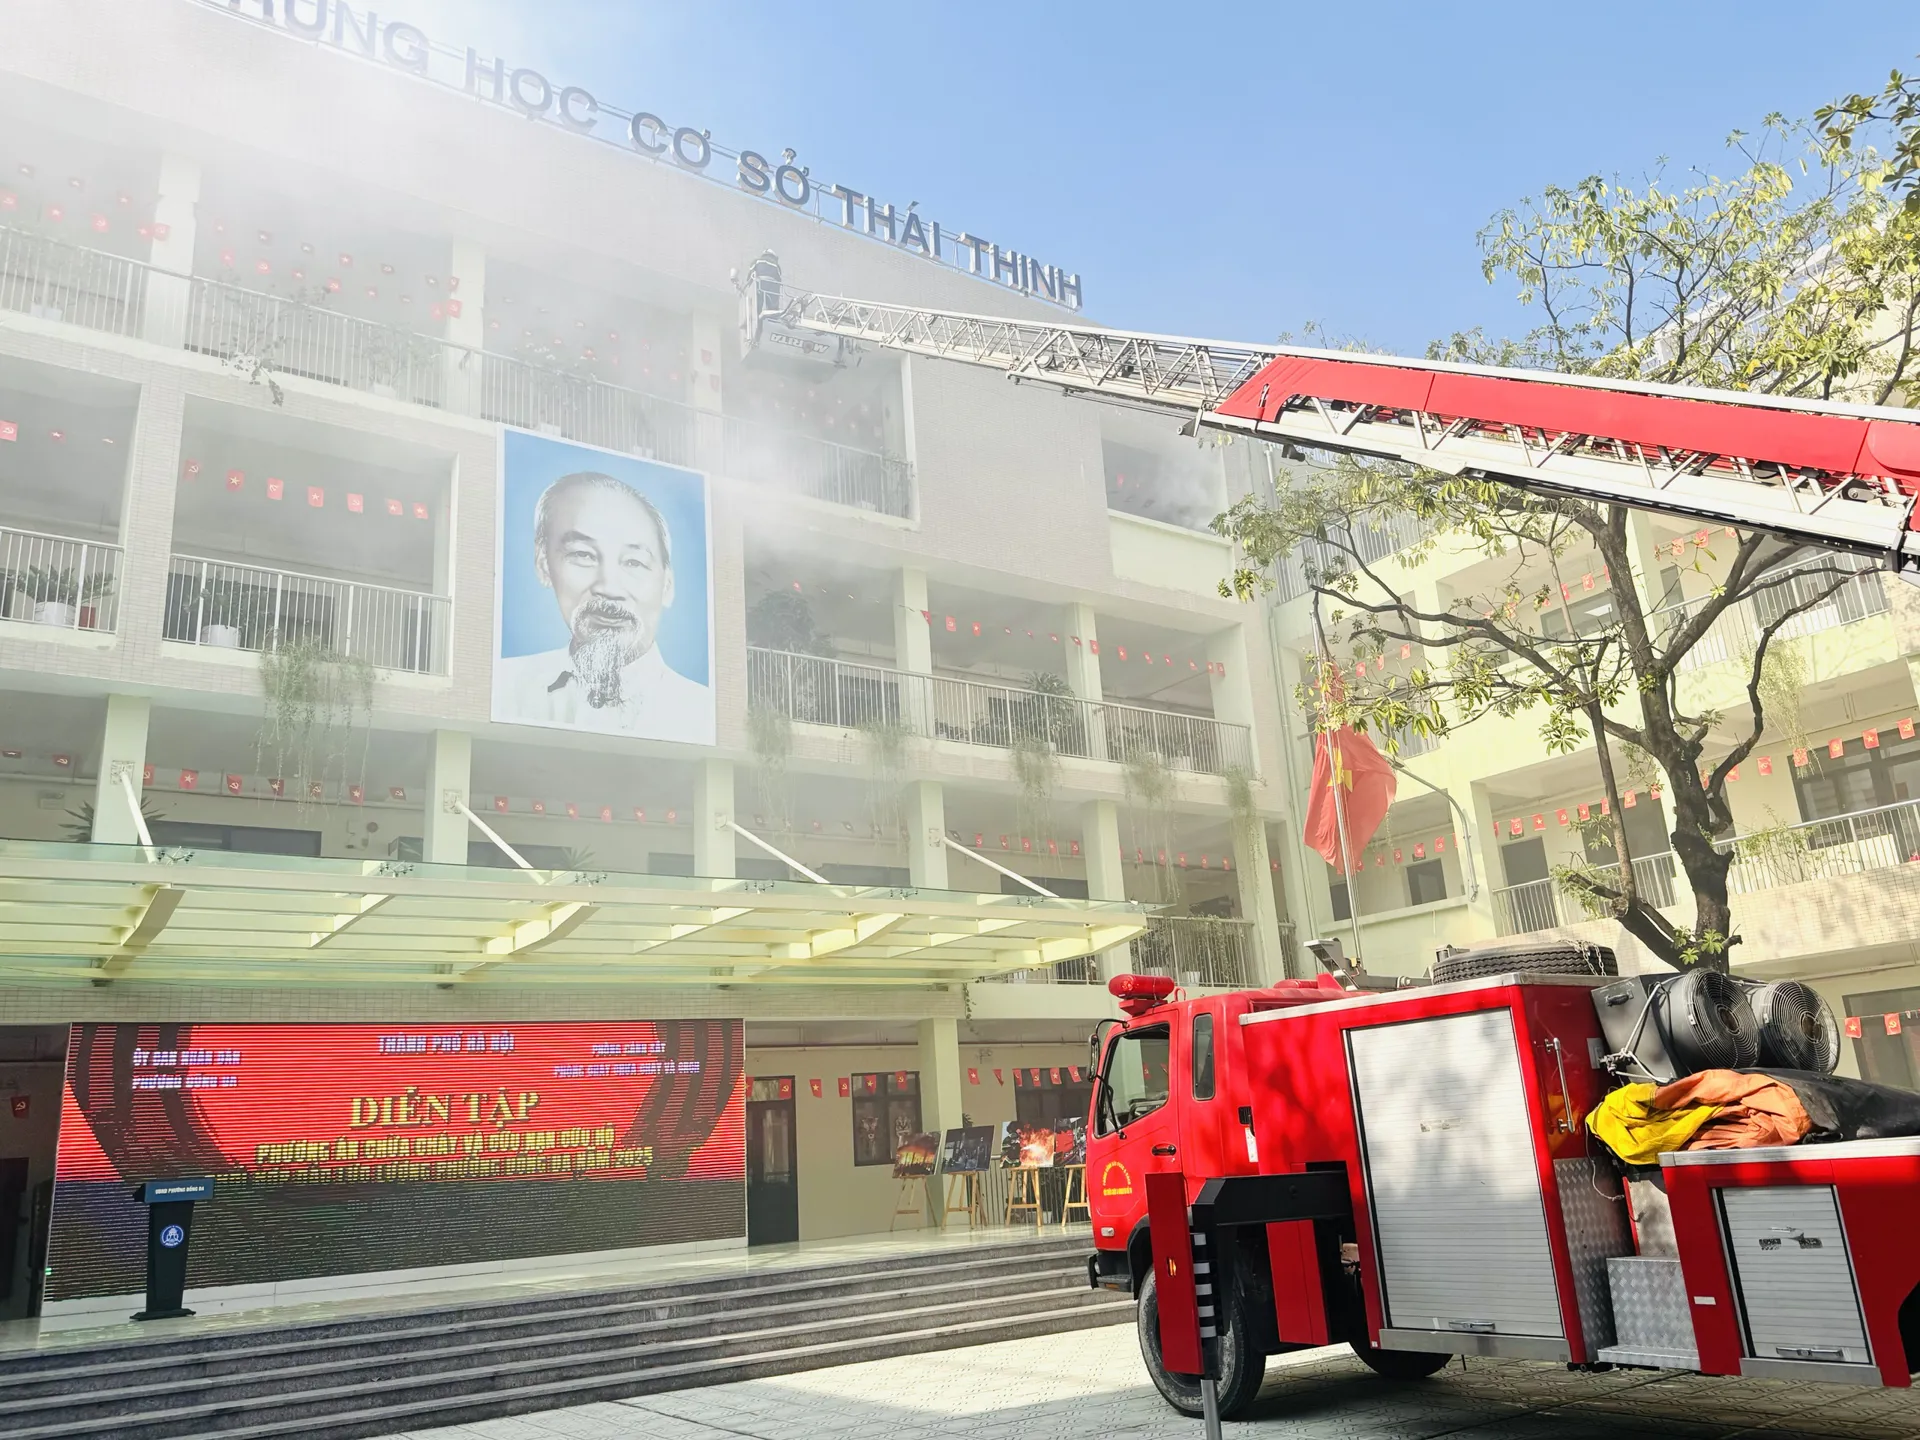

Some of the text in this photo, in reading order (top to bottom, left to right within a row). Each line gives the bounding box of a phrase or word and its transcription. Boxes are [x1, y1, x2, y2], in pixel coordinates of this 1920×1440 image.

[465, 46, 598, 134] HỌC
[627, 111, 712, 173] CƠ
[737, 147, 811, 208] SỞ
[831, 184, 942, 260] THÁI
[958, 231, 1083, 311] THỊNH
[350, 1086, 540, 1128] DIỄN TẬP
